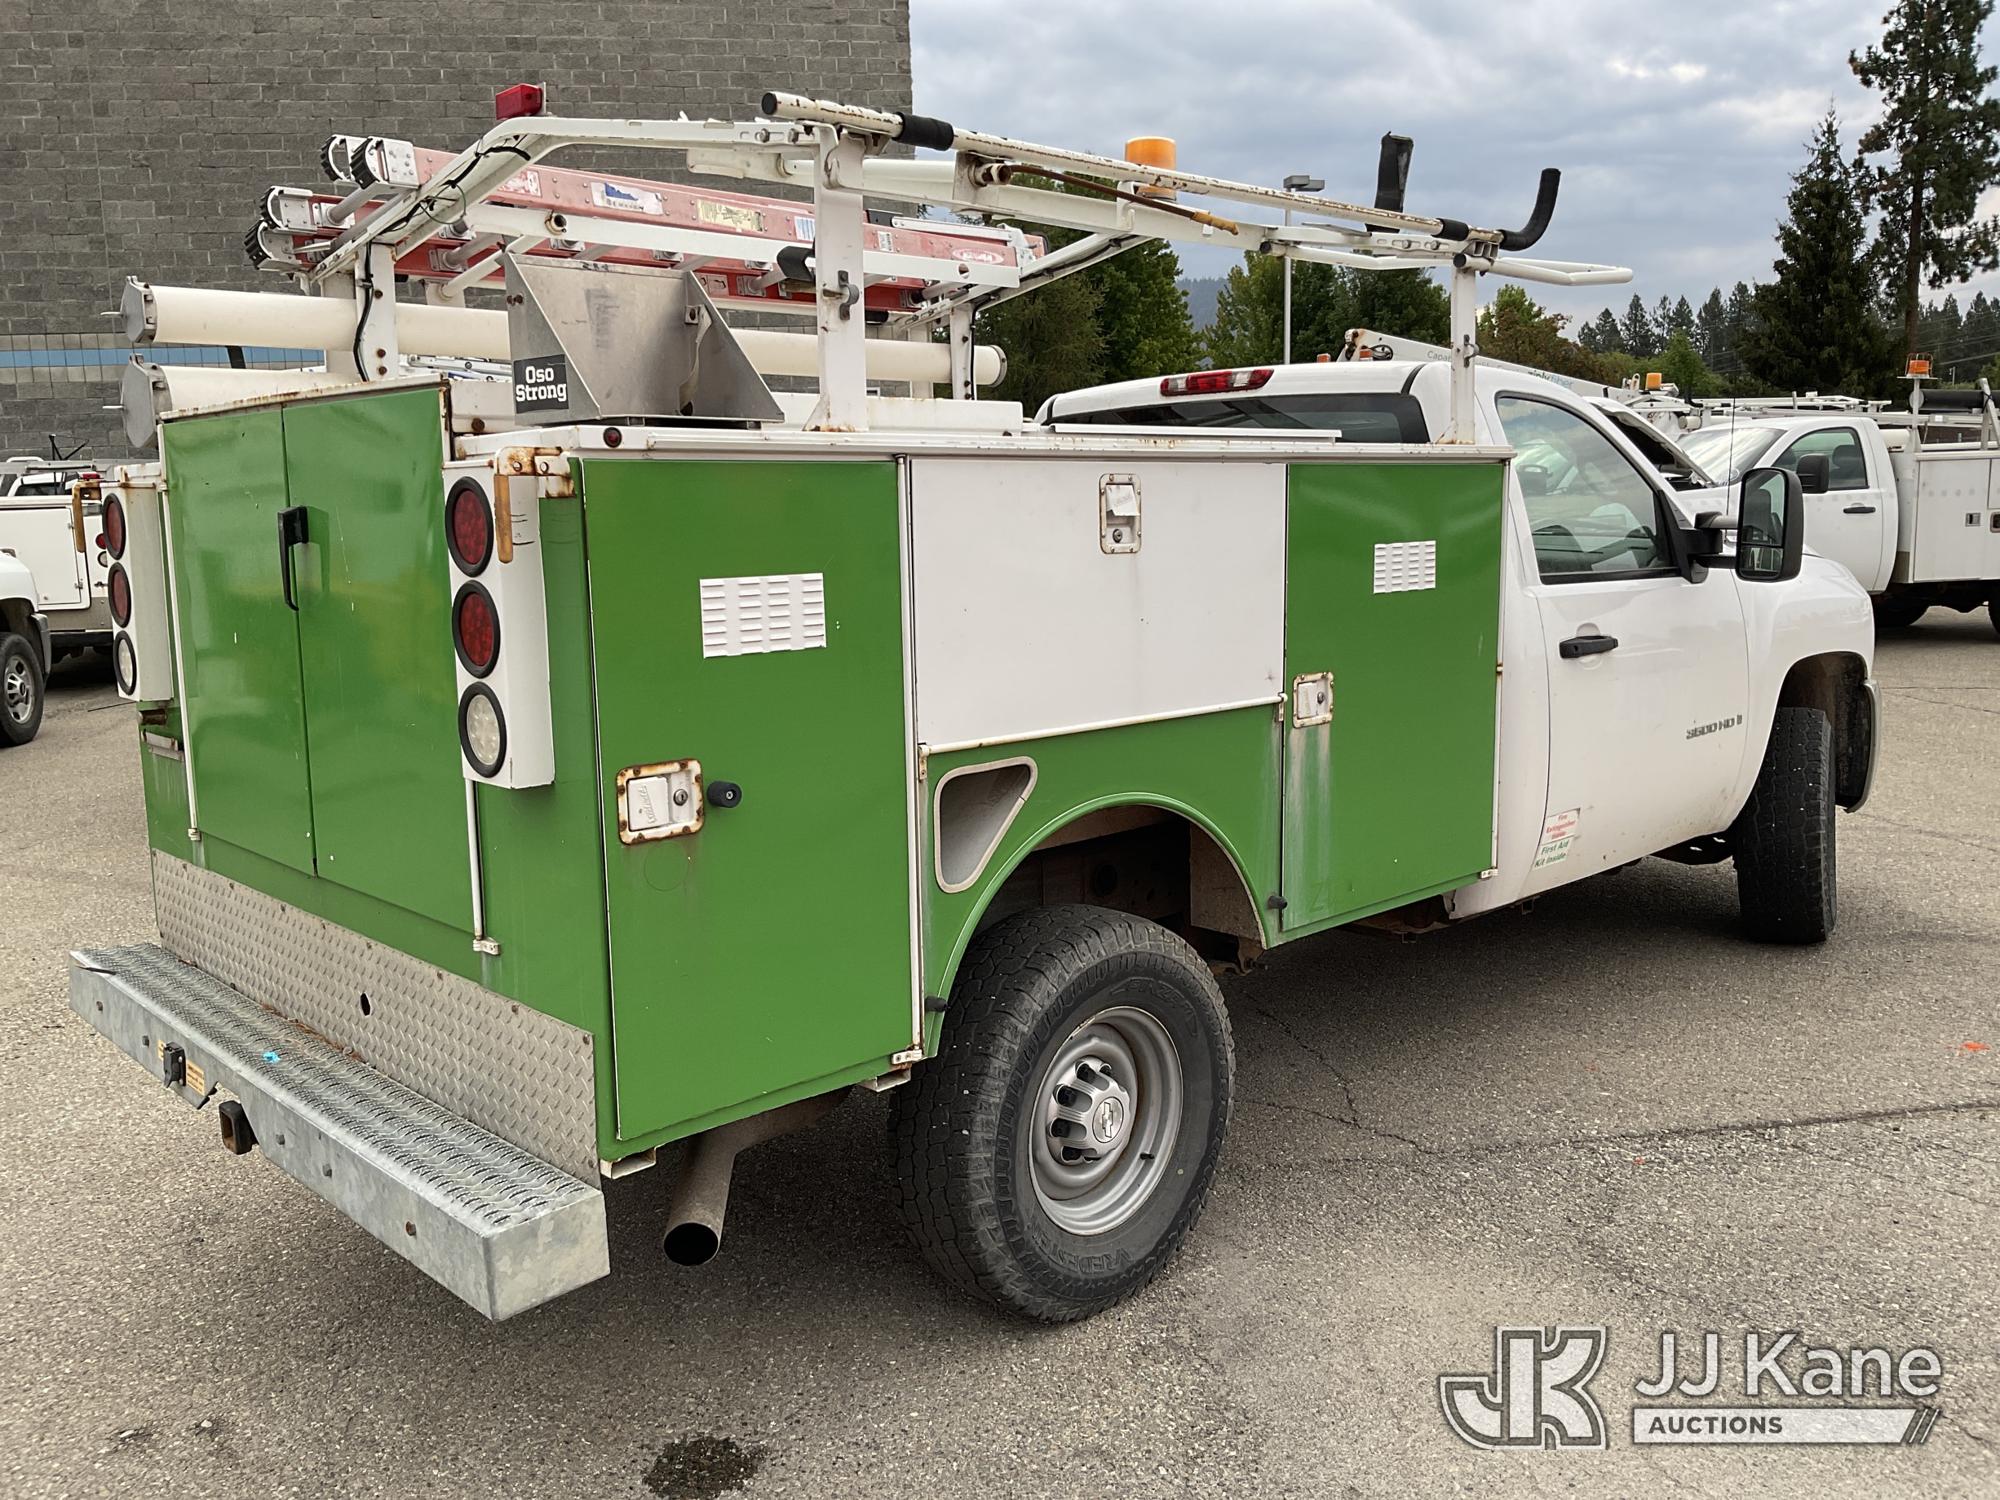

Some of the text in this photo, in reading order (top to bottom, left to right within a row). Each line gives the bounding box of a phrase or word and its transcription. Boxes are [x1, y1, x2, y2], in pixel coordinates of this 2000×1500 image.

[525, 366, 554, 383] Oso
[515, 383, 567, 402] Strong
[1541, 839, 1570, 855] First Aid
[1535, 853, 1567, 867] Kit Inside
